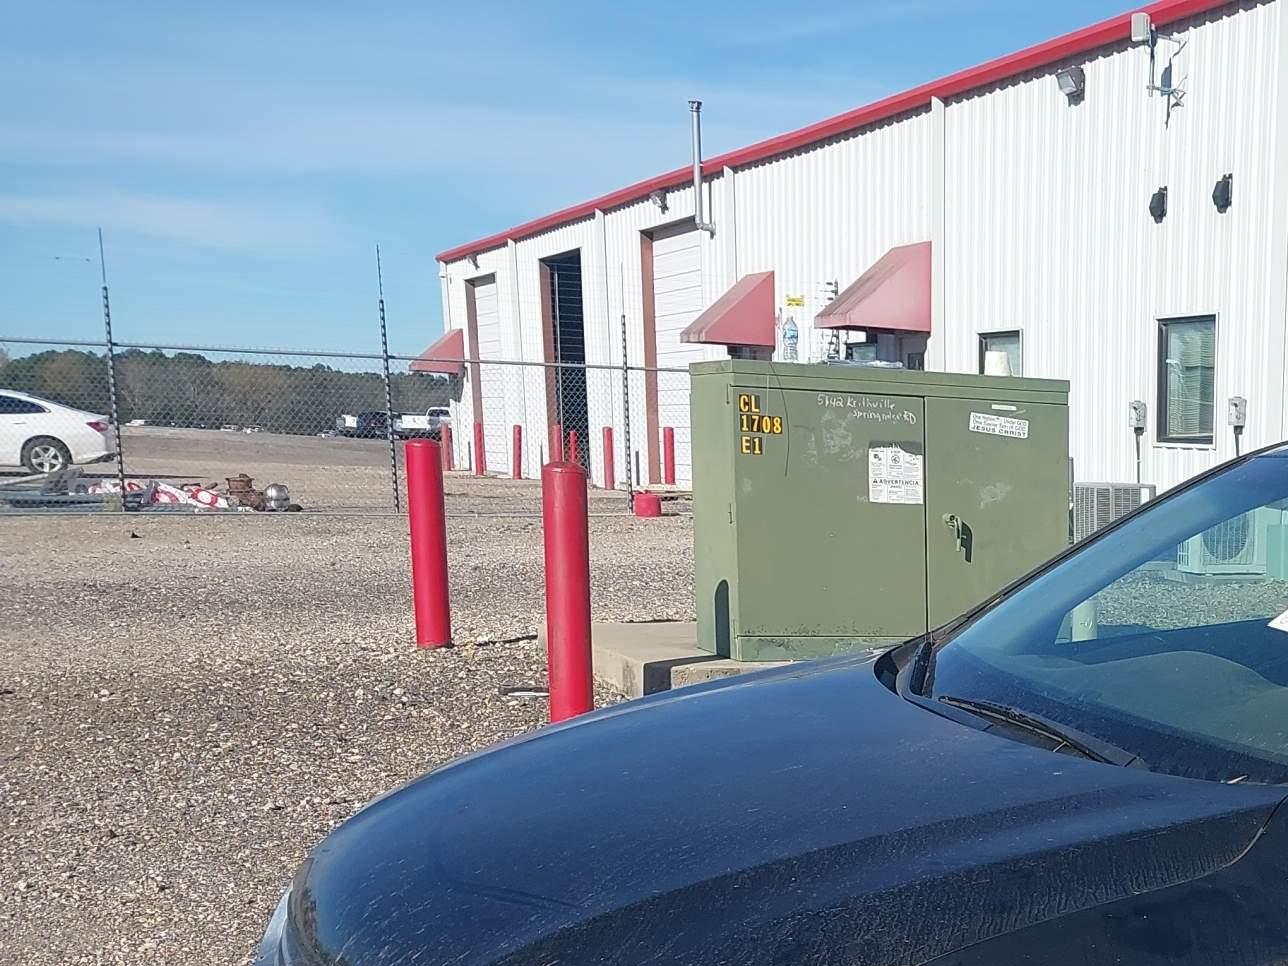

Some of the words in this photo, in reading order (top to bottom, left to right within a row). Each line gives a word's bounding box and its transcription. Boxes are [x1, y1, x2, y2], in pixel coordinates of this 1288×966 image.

[740, 395, 760, 412] CL
[741, 415, 782, 434] 1708
[971, 425, 996, 433] JESUS
[999, 428, 1026, 438] CHRIST
[742, 436, 761, 454] E1
